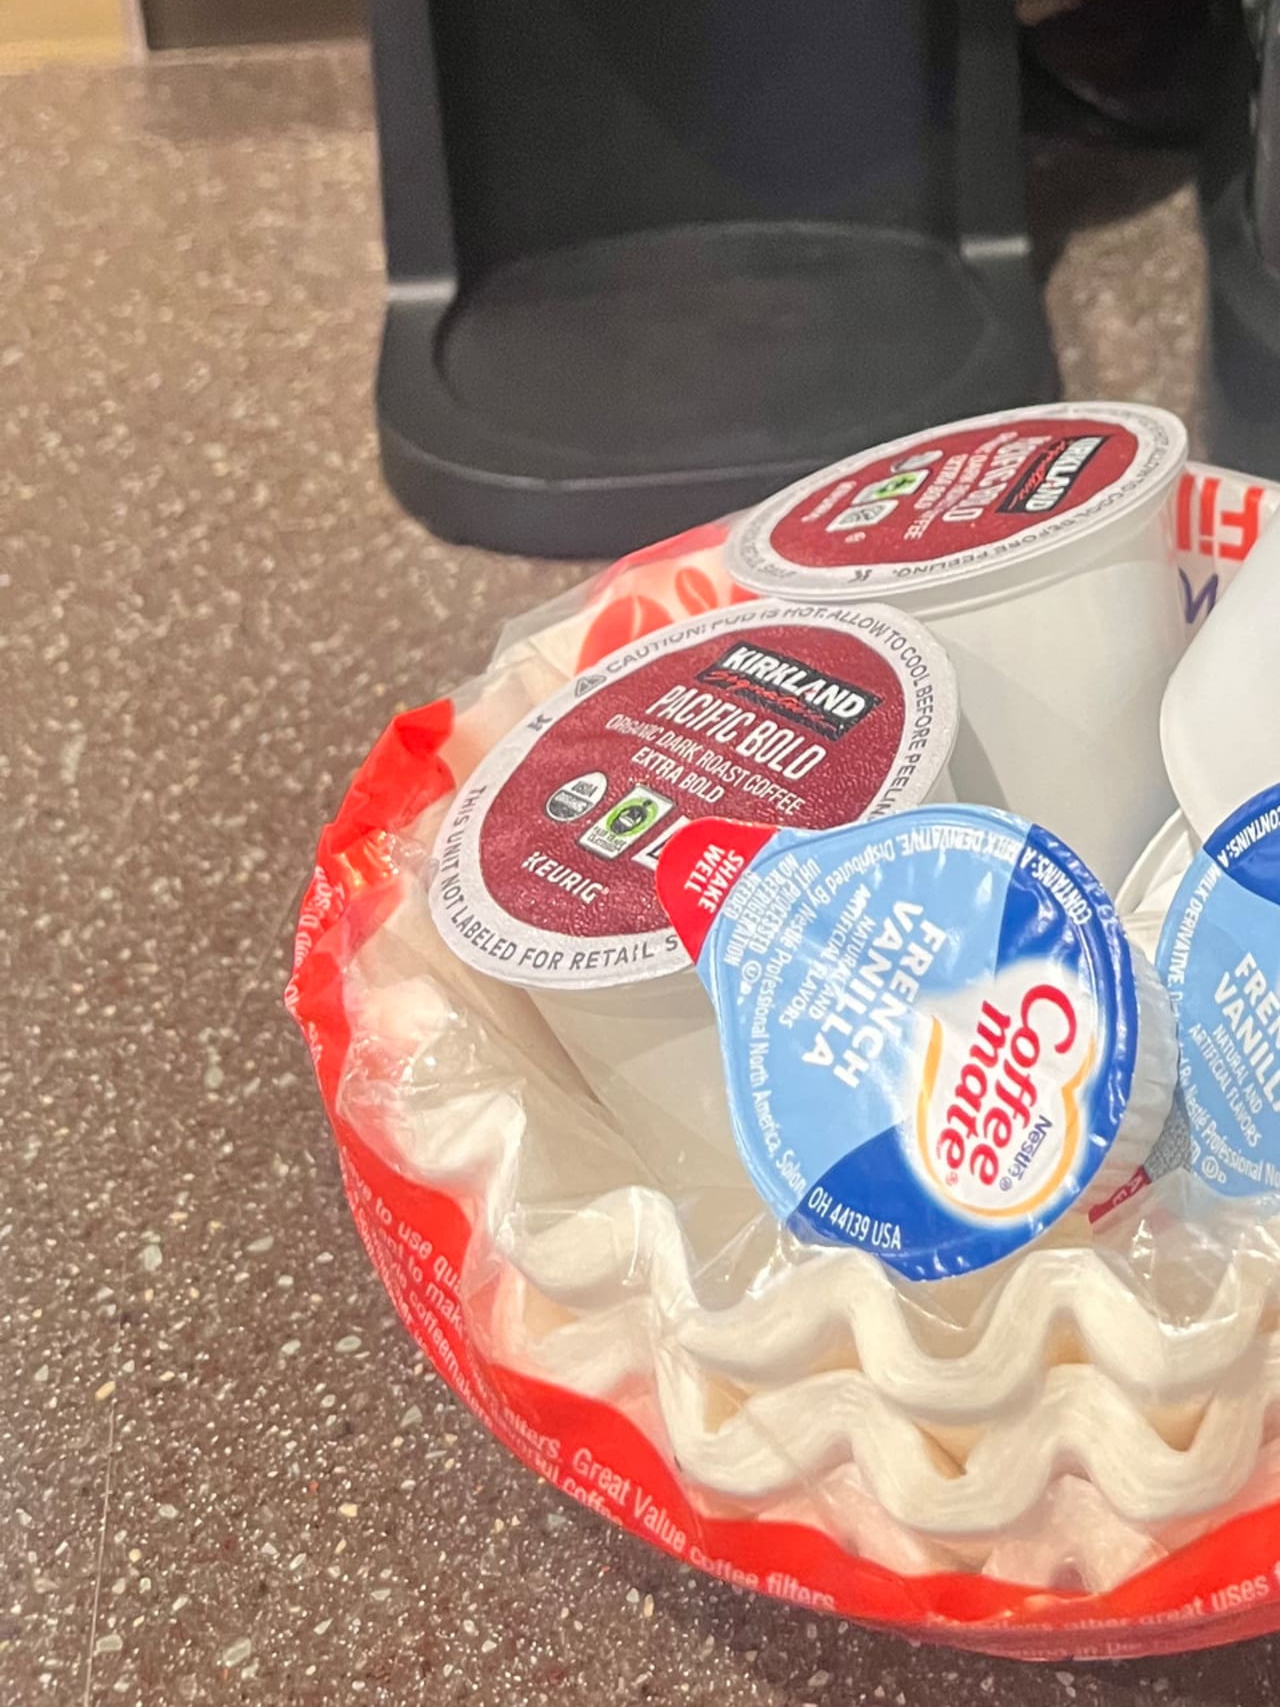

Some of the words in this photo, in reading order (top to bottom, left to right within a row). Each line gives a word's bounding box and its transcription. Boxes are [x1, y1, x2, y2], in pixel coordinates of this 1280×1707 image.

[606, 625, 706, 673] CAUTION:
[829, 607, 891, 638] ALLOW
[881, 630, 908, 651] TO
[722, 646, 867, 718] KIRKLAND
[899, 647, 930, 686] COOL
[645, 684, 756, 744] PACIFIC
[736, 719, 826, 781] BOLD
[908, 684, 934, 750] BEFORE
[605, 714, 664, 742] ORGANIC
[657, 728, 702, 763] DARK
[696, 748, 746, 787] ROAST
[743, 773, 806, 816] COFFEE
[631, 746, 684, 782] EXTRA
[679, 773, 725, 803] BOLD
[453, 785, 487, 827] THIS
[441, 829, 465, 873] UNIT
[522, 850, 602, 904] KEURIG
[684, 844, 725, 892] WELL
[825, 838, 896, 895] Distributed
[1019, 846, 1034, 870] A
[1216, 854, 1229, 869] A
[440, 873, 465, 911] NOT
[698, 850, 744, 914] SHAKE
[809, 889, 832, 910] By
[1030, 855, 1092, 926] CONTAINS:
[1193, 861, 1223, 900] MILK
[450, 906, 517, 961] LABELED
[750, 882, 802, 955] PROCESSED
[1166, 897, 1204, 988] DERIVATIVE.
[519, 947, 564, 971] FOR
[569, 942, 655, 971] RETAIL
[801, 900, 924, 1067] VANILLA
[751, 947, 793, 1039] Professional
[778, 960, 829, 1030] FLAVORS
[833, 919, 947, 1088] FRENCH
[749, 1042, 769, 1089] North
[937, 1000, 1011, 1170] mate
[970, 984, 1077, 1186] Coffee
[1188, 1022, 1234, 1093] ARTIFICIAL
[1225, 1087, 1262, 1148] FLAVORS
[1213, 1023, 1250, 1086] NATURAL
[1243, 1082, 1263, 1114] AND
[1201, 1120, 1262, 1182] Professional
[375, 1195, 394, 1226] to
[397, 1215, 434, 1259] use
[807, 1186, 833, 1218] OH
[829, 1203, 872, 1242] 44139
[871, 1218, 902, 1250] USA
[408, 1252, 424, 1286] to
[572, 1447, 631, 1506] Great
[632, 1486, 687, 1550] Value
[688, 1545, 760, 1589] coffee
[766, 1571, 836, 1612] filters
[1211, 1578, 1270, 1613] uses
